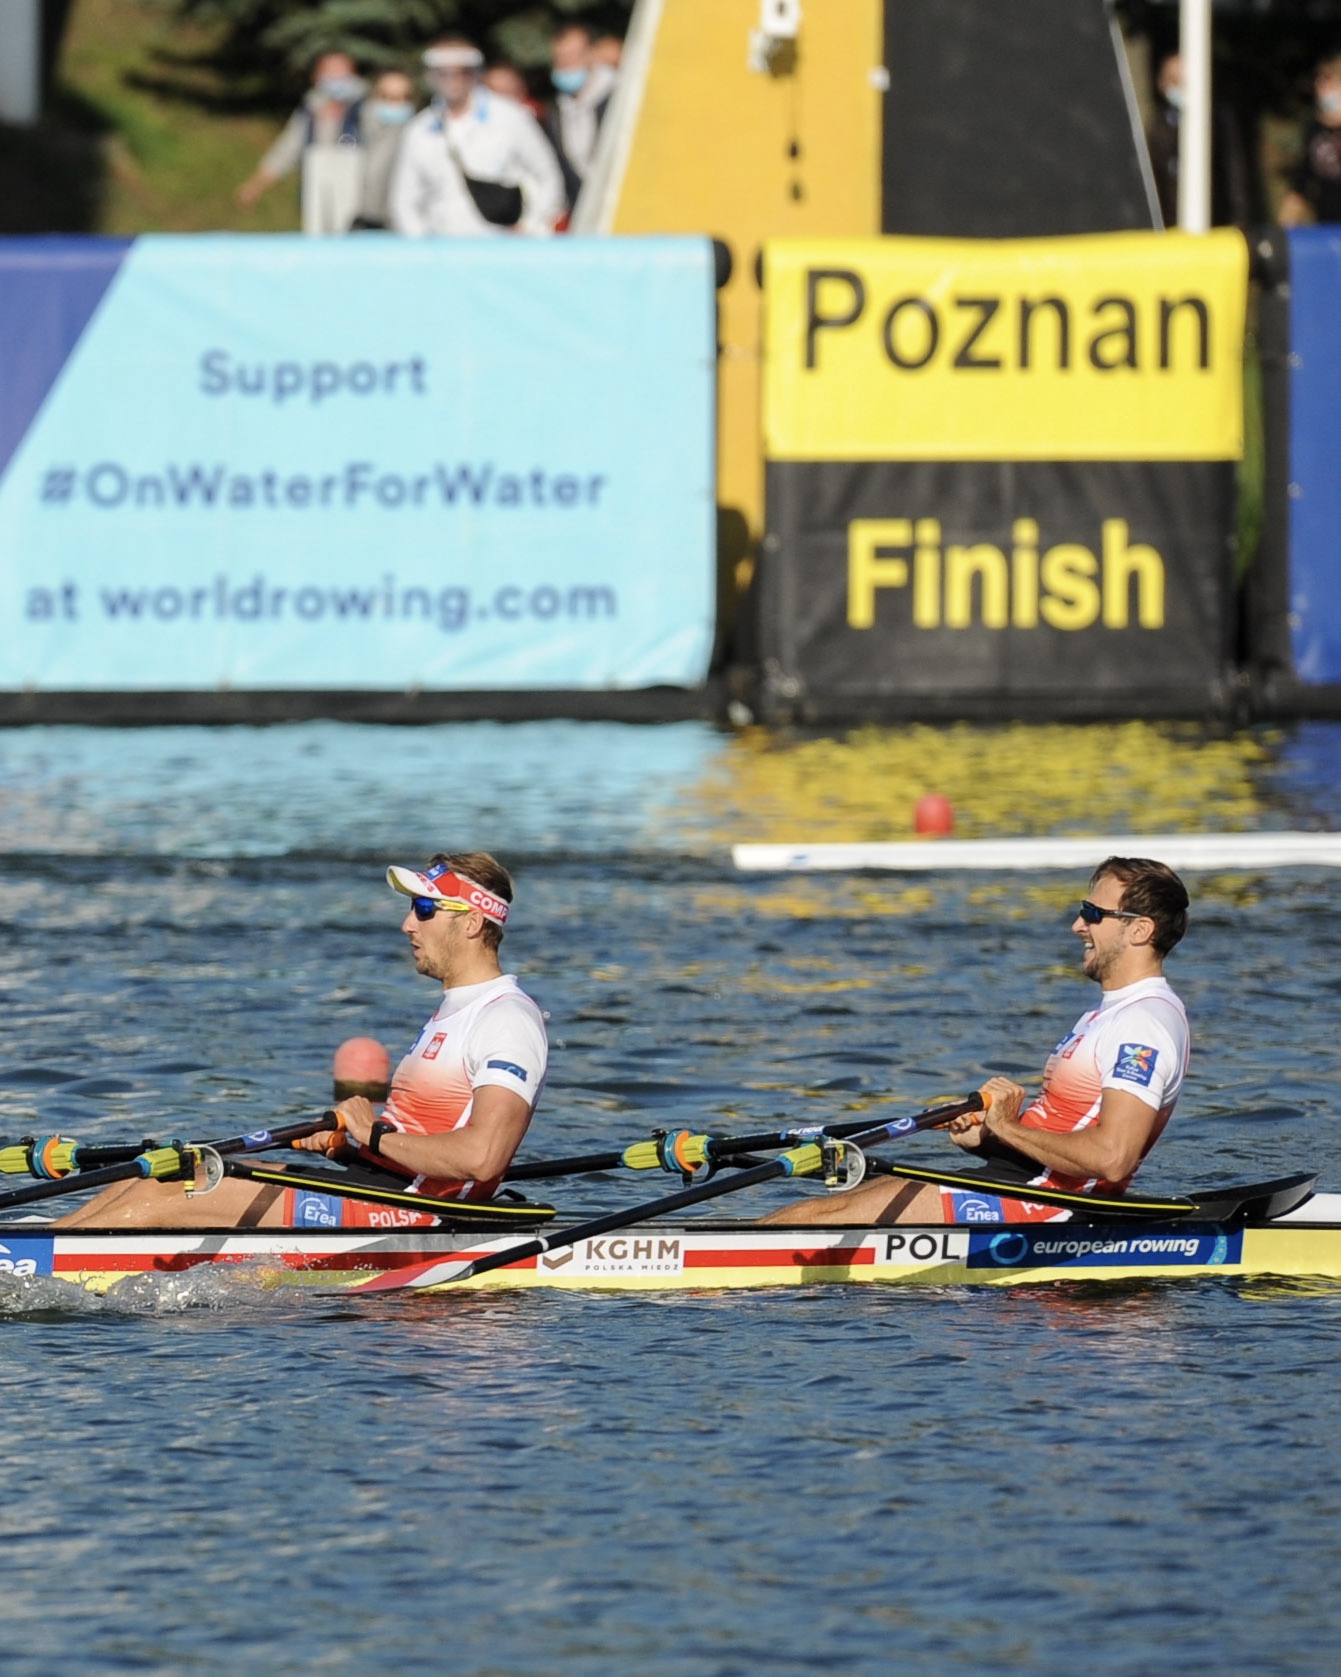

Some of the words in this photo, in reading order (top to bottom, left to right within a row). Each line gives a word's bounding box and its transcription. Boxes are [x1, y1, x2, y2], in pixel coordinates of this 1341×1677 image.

[802, 267, 1211, 372] Poznan
[199, 350, 427, 405] Support
[40, 462, 608, 510] #OnWaterForWater
[847, 517, 1166, 631] Finish
[26, 583, 80, 622] at
[98, 574, 618, 633] worldrowing.com
[966, 1207, 999, 1222] Enea
[586, 1239, 680, 1260] KGHM
[885, 1234, 961, 1260] POL
[1033, 1239, 1127, 1257] european
[1129, 1238, 1200, 1257] rowing
